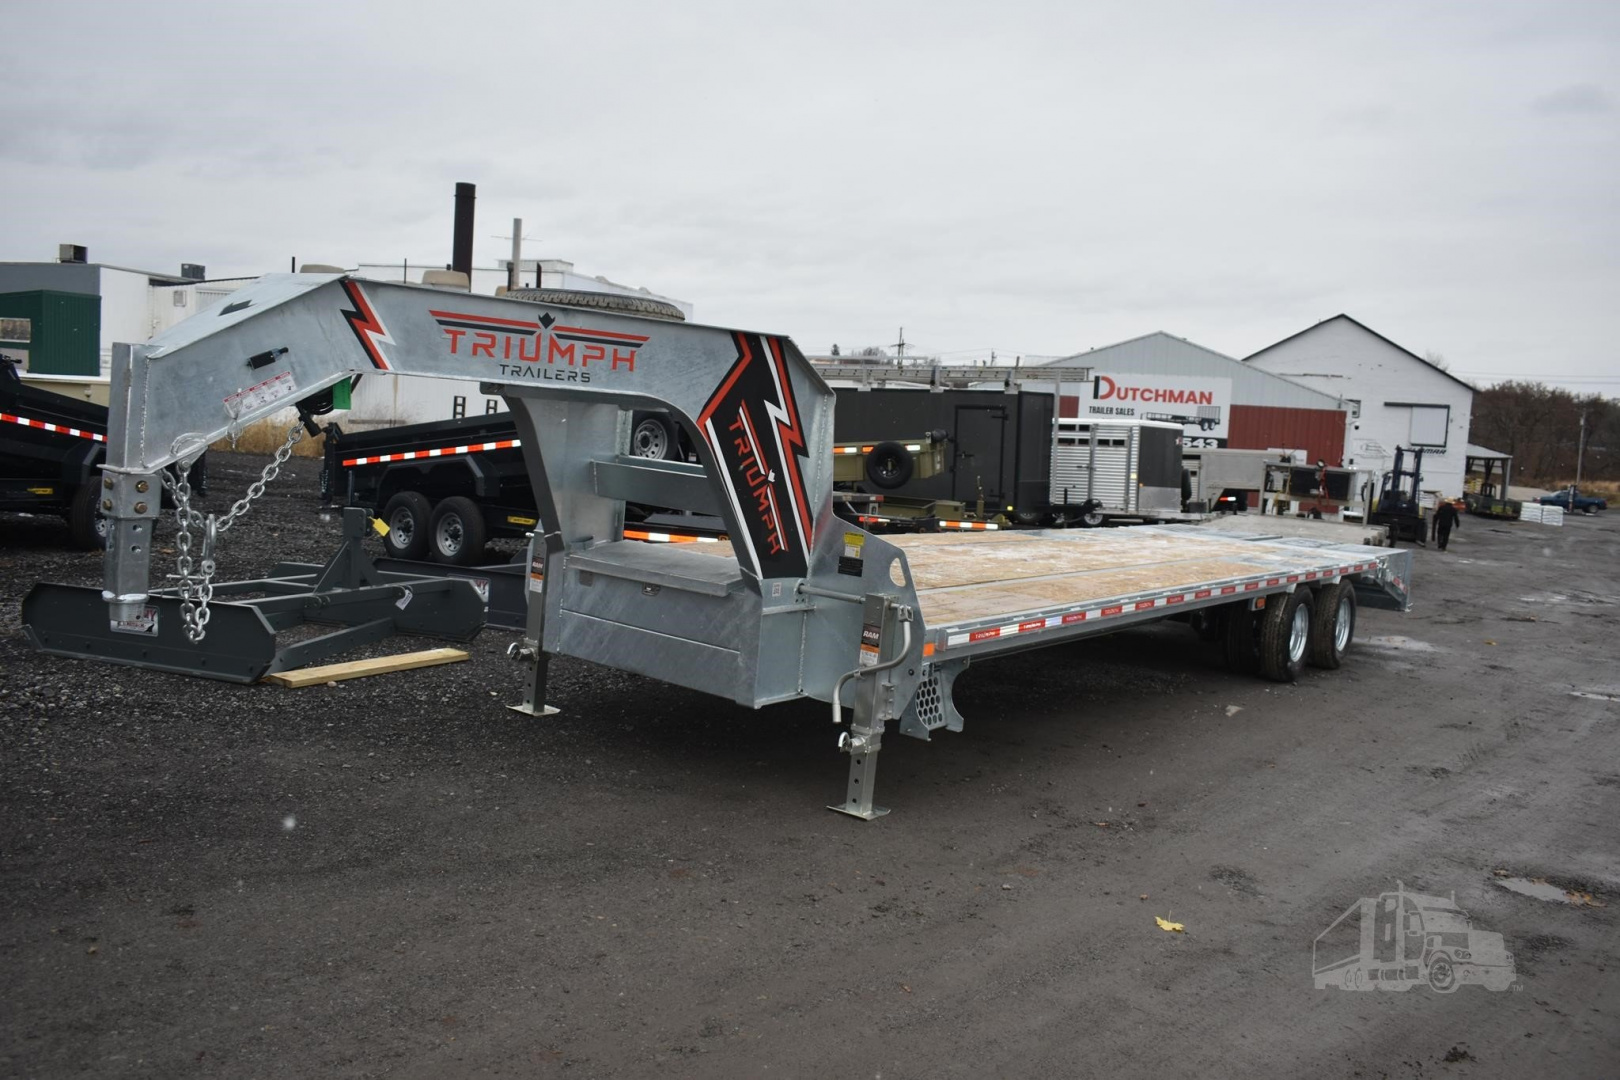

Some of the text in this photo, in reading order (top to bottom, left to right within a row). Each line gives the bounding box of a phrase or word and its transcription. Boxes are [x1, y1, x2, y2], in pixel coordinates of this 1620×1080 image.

[443, 328, 637, 372] TRIUMPH
[499, 363, 591, 383] TRAILERS
[1093, 375, 1213, 405] DUTCHMAN
[1088, 405, 1135, 416] TRAILER SALES
[728, 413, 782, 555] TRIUMPH
[862, 630, 880, 640] RAM
